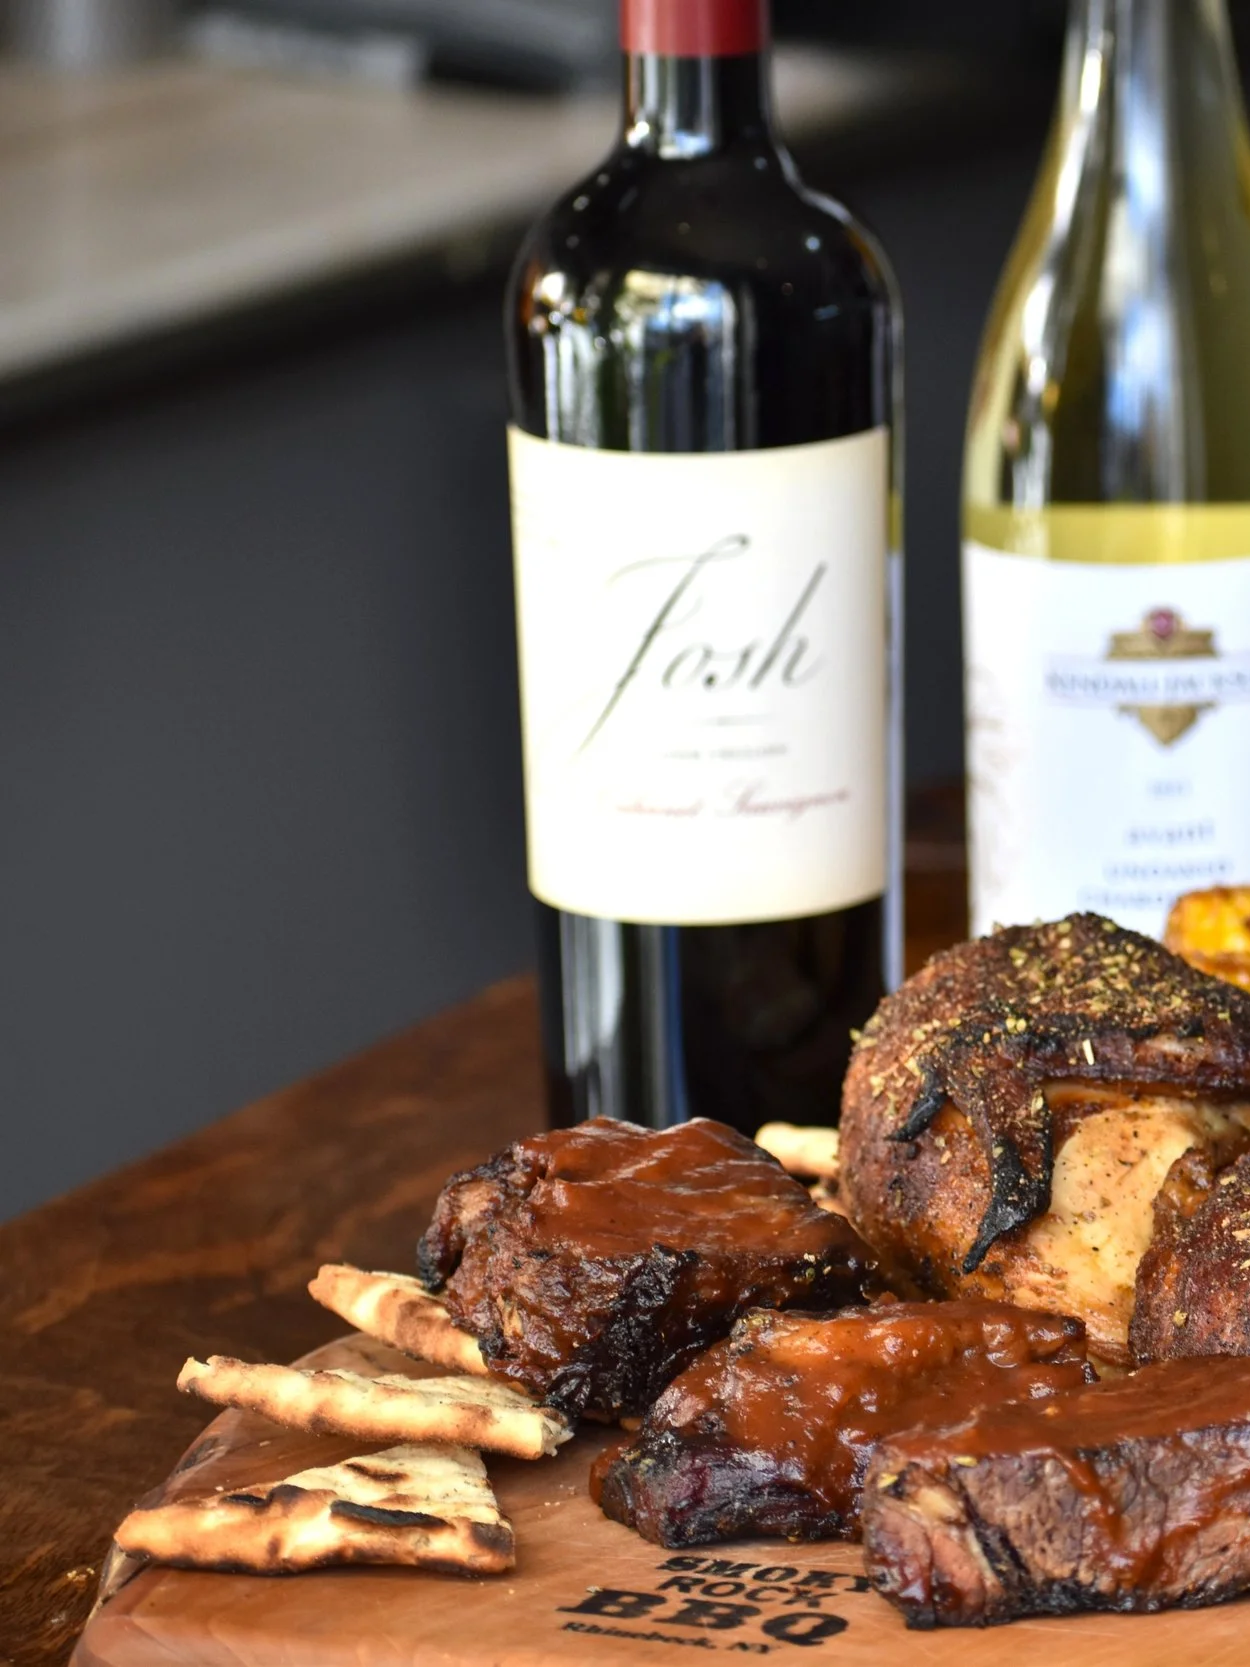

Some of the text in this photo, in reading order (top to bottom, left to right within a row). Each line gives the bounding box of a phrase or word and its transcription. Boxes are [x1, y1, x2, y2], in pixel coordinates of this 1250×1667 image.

[570, 533, 828, 762] Josh
[555, 1587, 849, 1646] BBQ
[655, 1576, 837, 1607] ROCK
